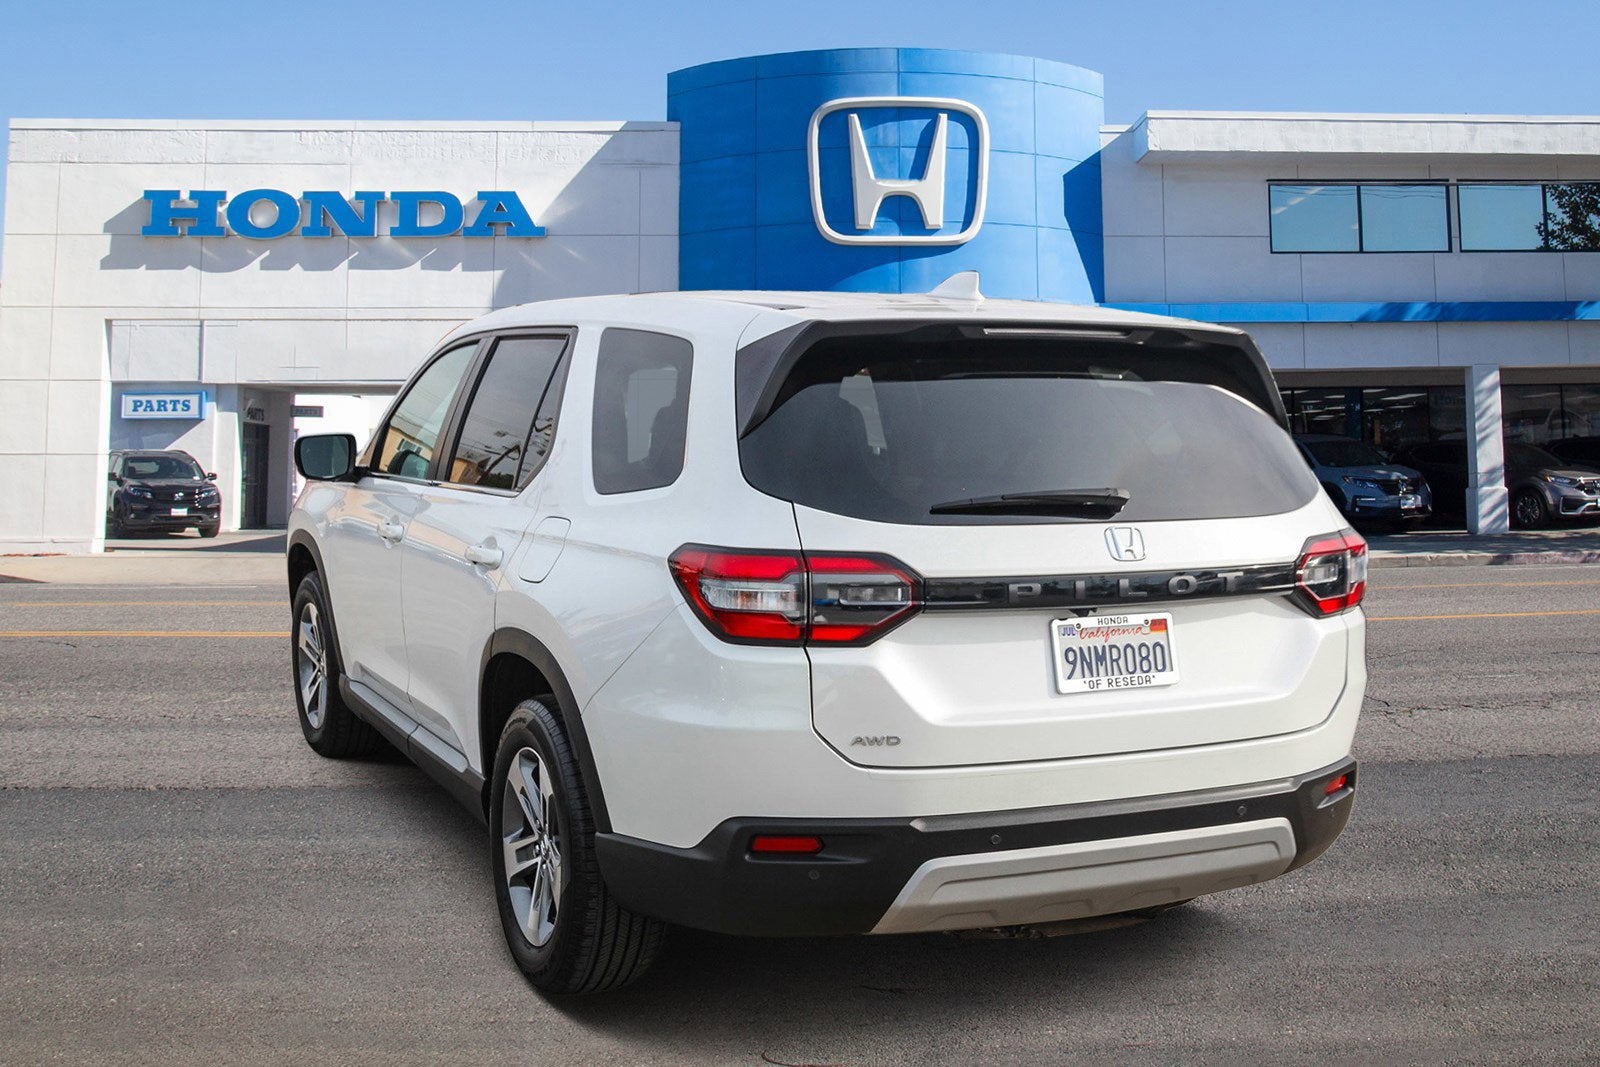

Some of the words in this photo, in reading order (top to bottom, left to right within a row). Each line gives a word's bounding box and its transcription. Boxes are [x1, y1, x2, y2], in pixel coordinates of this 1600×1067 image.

[142, 189, 547, 239] HONDA
[131, 399, 191, 413] PARTS
[1008, 571, 1244, 600] PILOT
[1097, 616, 1129, 626] HONDA
[1062, 627, 1076, 637] JUL
[1079, 625, 1151, 643] California
[1064, 641, 1167, 680] 9NMR080
[851, 735, 902, 746] AWD
